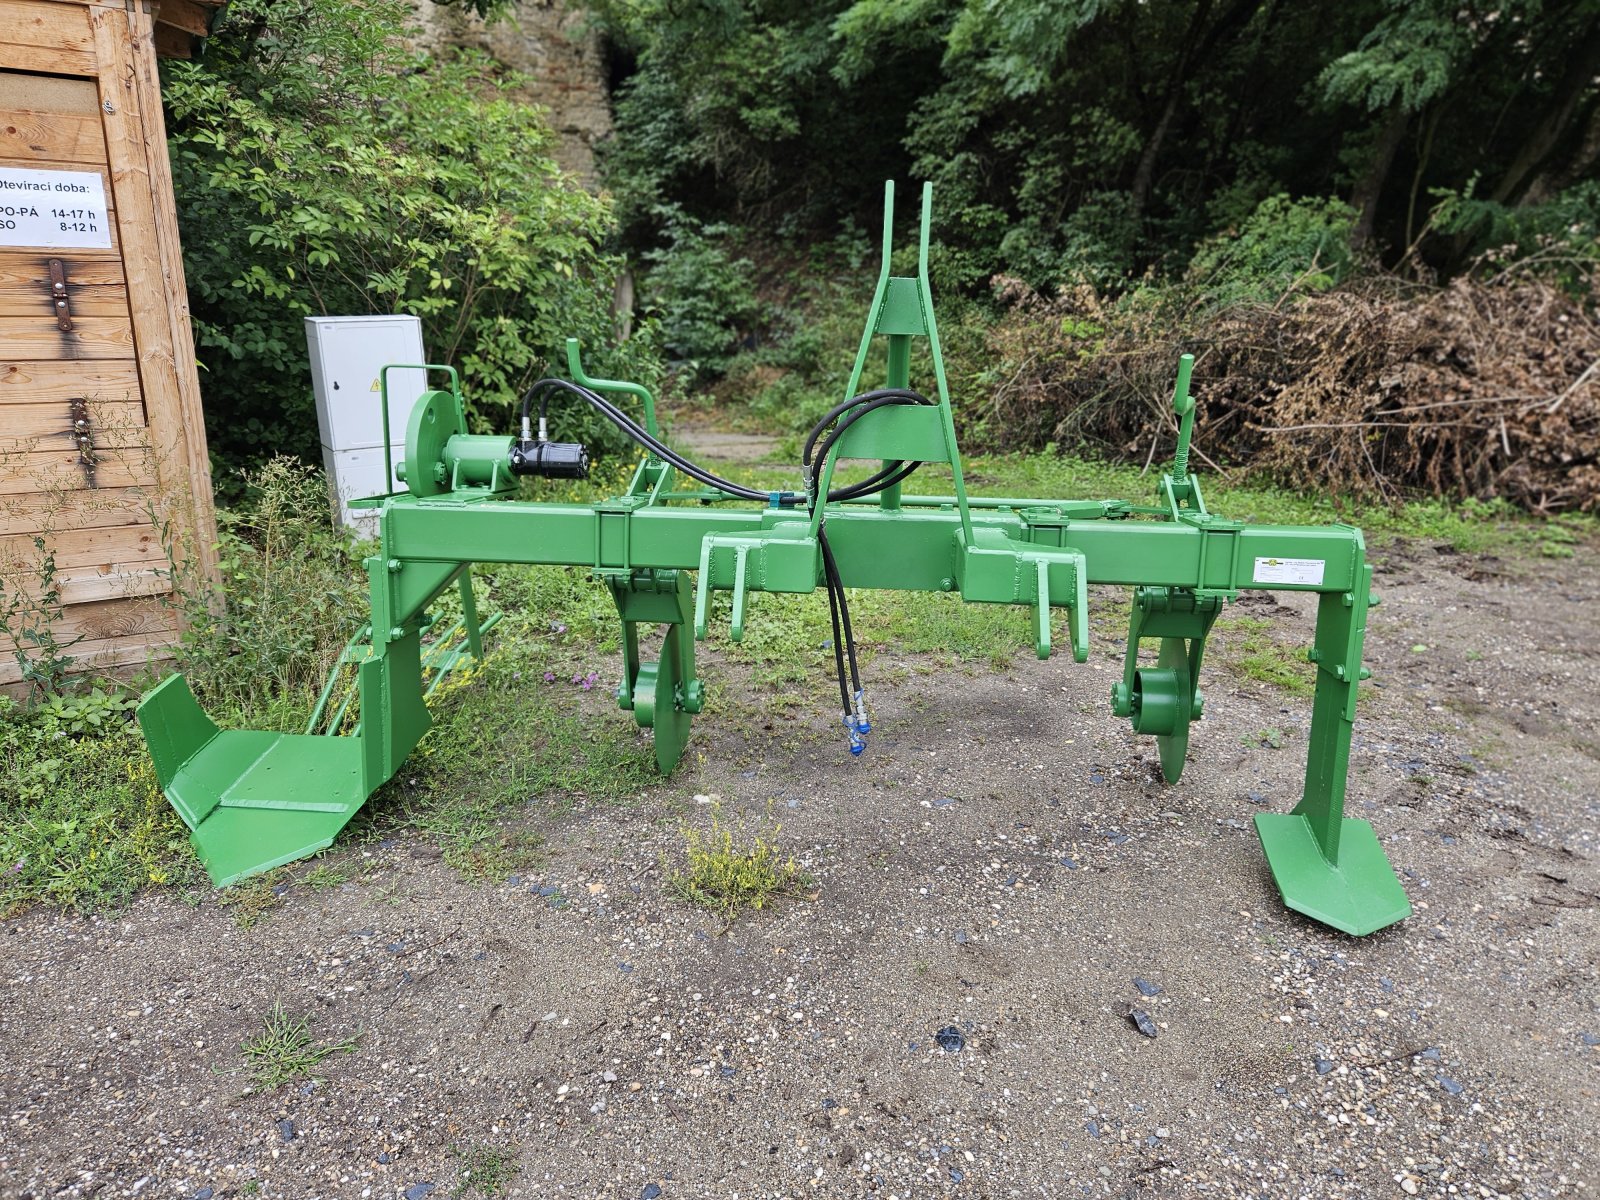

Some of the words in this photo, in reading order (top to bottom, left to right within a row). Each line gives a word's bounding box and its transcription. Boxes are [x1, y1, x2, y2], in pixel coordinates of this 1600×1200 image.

[55, 182, 90, 193] doba:
[51, 208, 83, 219] 14-17
[88, 210, 95, 219] h
[60, 222, 86, 232] 8-12
[90, 223, 97, 232] h
